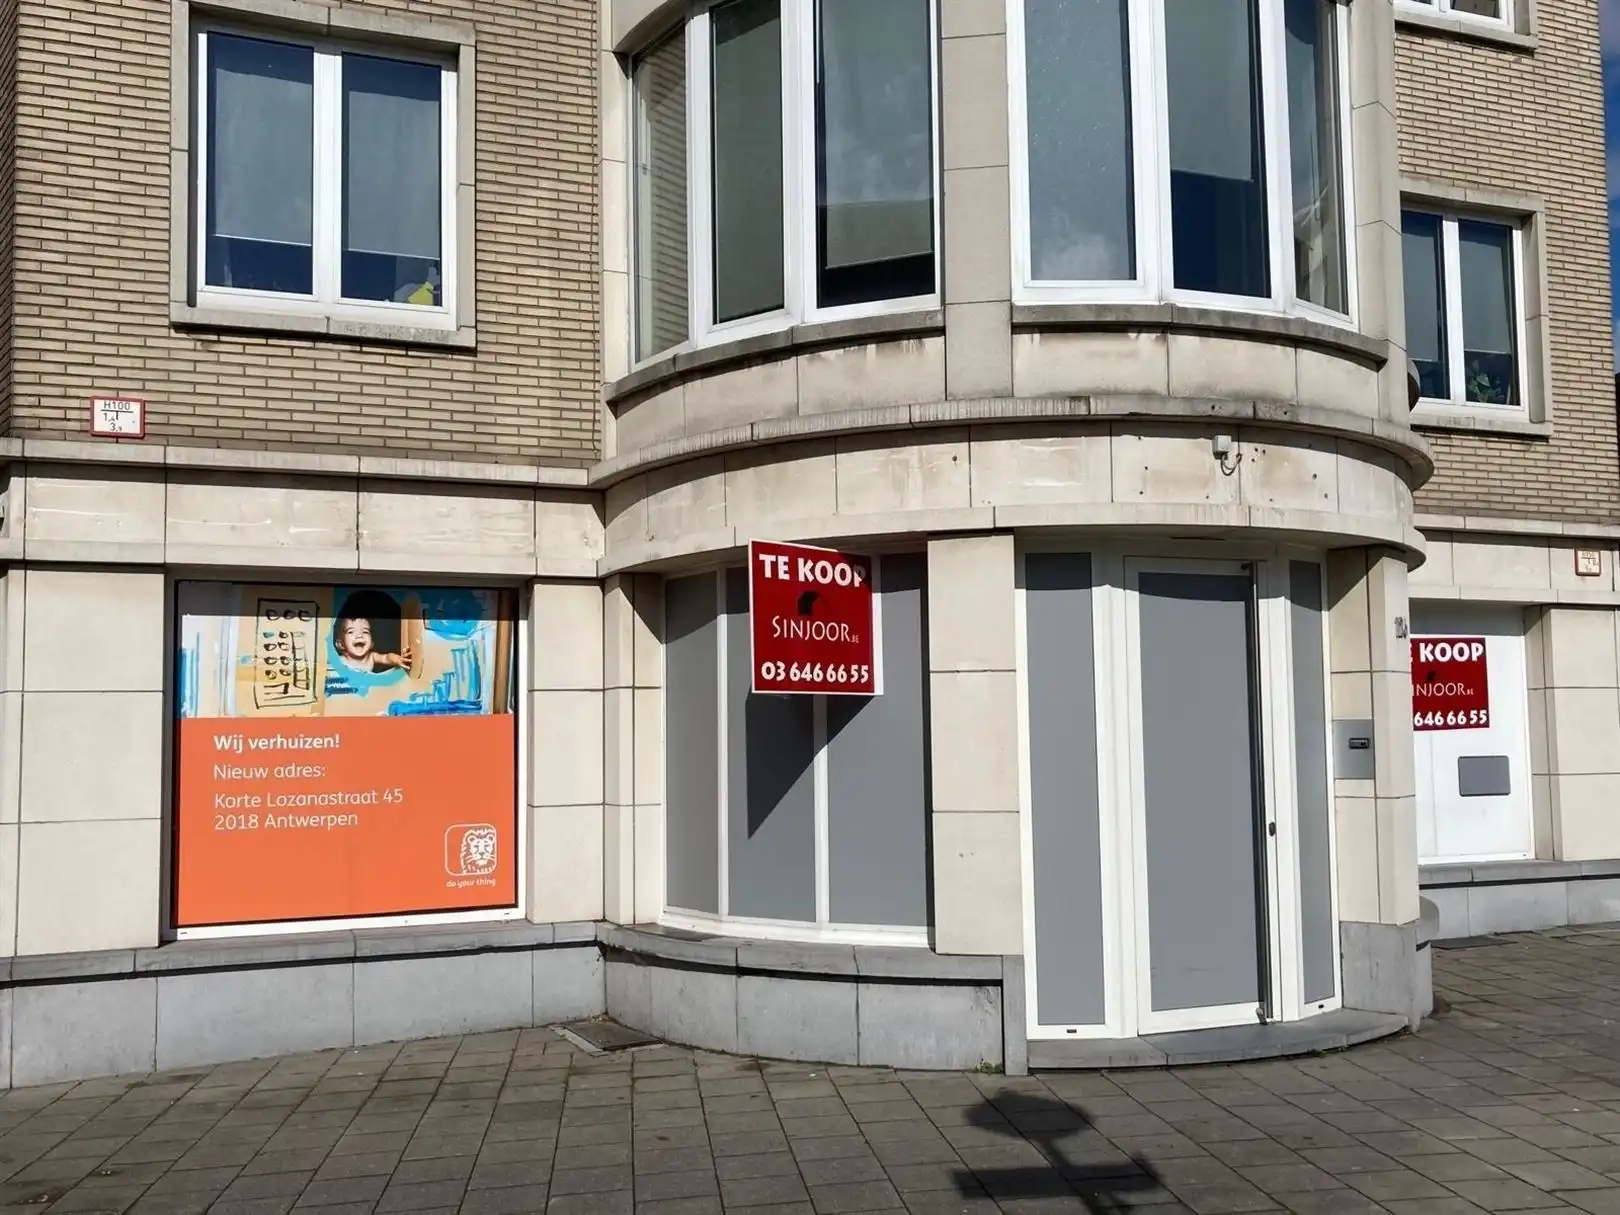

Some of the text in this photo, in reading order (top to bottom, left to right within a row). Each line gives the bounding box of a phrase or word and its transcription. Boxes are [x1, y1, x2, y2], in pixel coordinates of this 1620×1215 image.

[104, 401, 130, 410] H100
[759, 553, 866, 588] TE KOOP
[1419, 642, 1484, 662] KOOP
[761, 661, 869, 684] 03 646 66 55
[1414, 709, 1488, 727] 646 66 55
[213, 734, 340, 754] Wij verhuizen!
[213, 762, 326, 780] Nieuw adres:
[214, 788, 404, 809] Korte Lozanastraat 45
[214, 813, 359, 831] 2018 Antwerpen
[446, 878, 497, 889] do your thing
